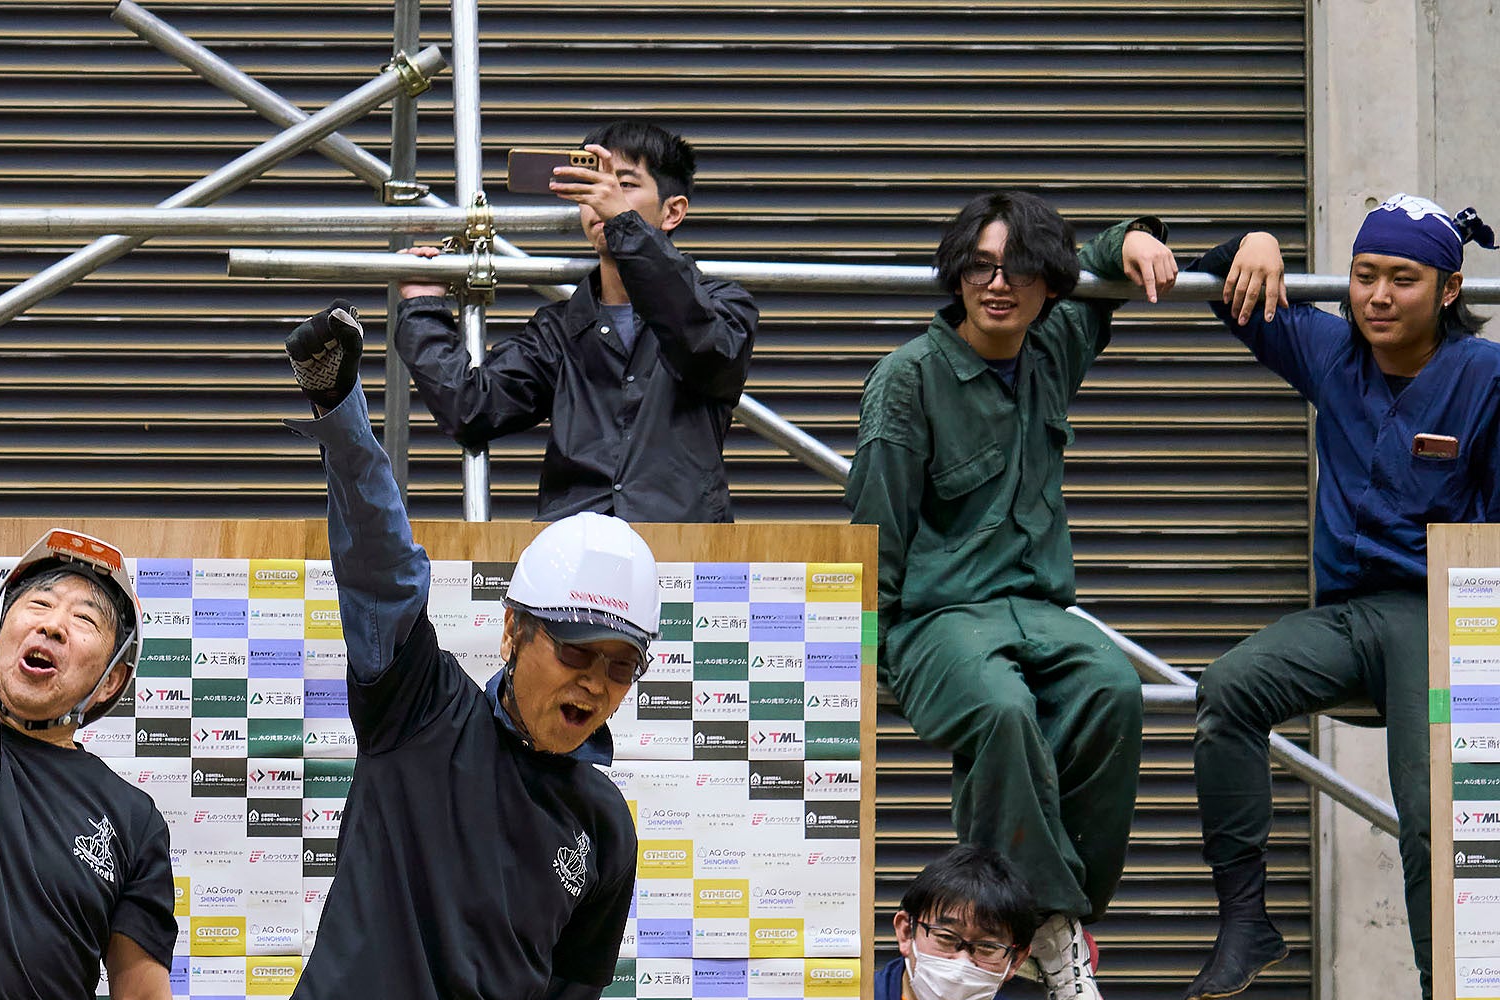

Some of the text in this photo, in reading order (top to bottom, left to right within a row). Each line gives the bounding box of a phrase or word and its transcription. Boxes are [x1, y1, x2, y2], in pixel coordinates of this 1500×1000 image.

[319, 569, 332, 577] AQ
[154, 614, 189, 624] 大三商行
[711, 618, 747, 628] 大三商行
[210, 655, 245, 665] 大三商行
[657, 654, 692, 664] TML
[766, 658, 802, 668] 大三商行
[155, 690, 190, 700] TML
[265, 695, 301, 705] 大三商行
[712, 693, 747, 703] TML
[822, 697, 858, 708] 大三商行
[211, 730, 245, 740] TML
[320, 734, 356, 744] 大三商行
[768, 732, 803, 743] TML
[267, 770, 301, 781] TML
[824, 773, 859, 783] TML
[652, 809, 690, 818] AQ Group
[645, 851, 684, 859] SYNEGIC
[708, 848, 746, 857] AQ Group
[205, 886, 243, 895] AQ Group
[701, 890, 740, 898] SYNEGIC
[764, 888, 801, 897] AQ Group
[261, 925, 299, 934] AQ Group
[757, 929, 795, 937] SYNEGIC
[254, 967, 293, 975] SYNEGIC
[654, 974, 690, 985] 大三商行
